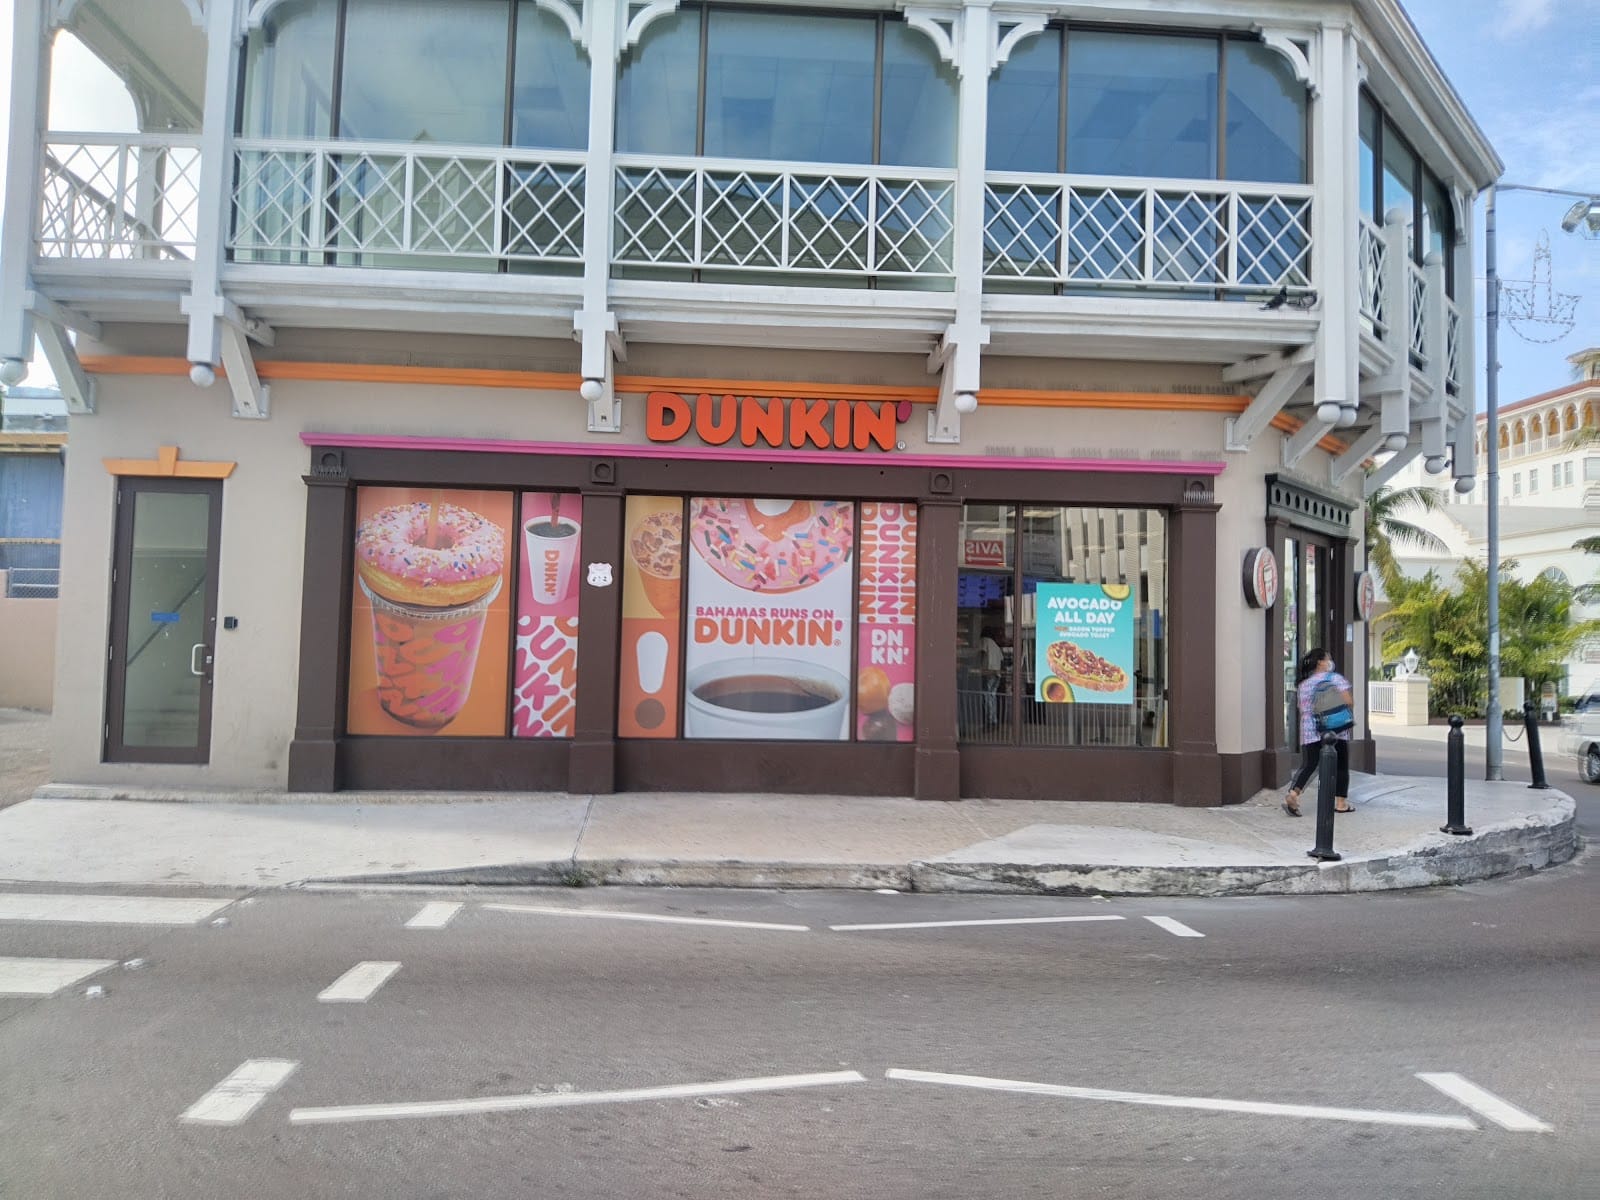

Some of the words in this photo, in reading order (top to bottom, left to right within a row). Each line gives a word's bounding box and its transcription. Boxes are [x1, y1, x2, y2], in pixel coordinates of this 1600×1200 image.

[646, 391, 912, 451] DUNKIN'
[878, 502, 900, 623] DUNKIN'
[900, 502, 917, 625] DUNKIN
[696, 606, 767, 618] BAHAMAS
[770, 607, 809, 619] RUNS
[812, 609, 834, 620] ON
[1047, 597, 1122, 611] AVOCADO
[1054, 611, 1083, 624] ALL
[1086, 612, 1116, 625] DAY
[694, 617, 843, 647] DUNKIN'
[871, 628, 904, 647] DN
[871, 646, 910, 665] KN'
